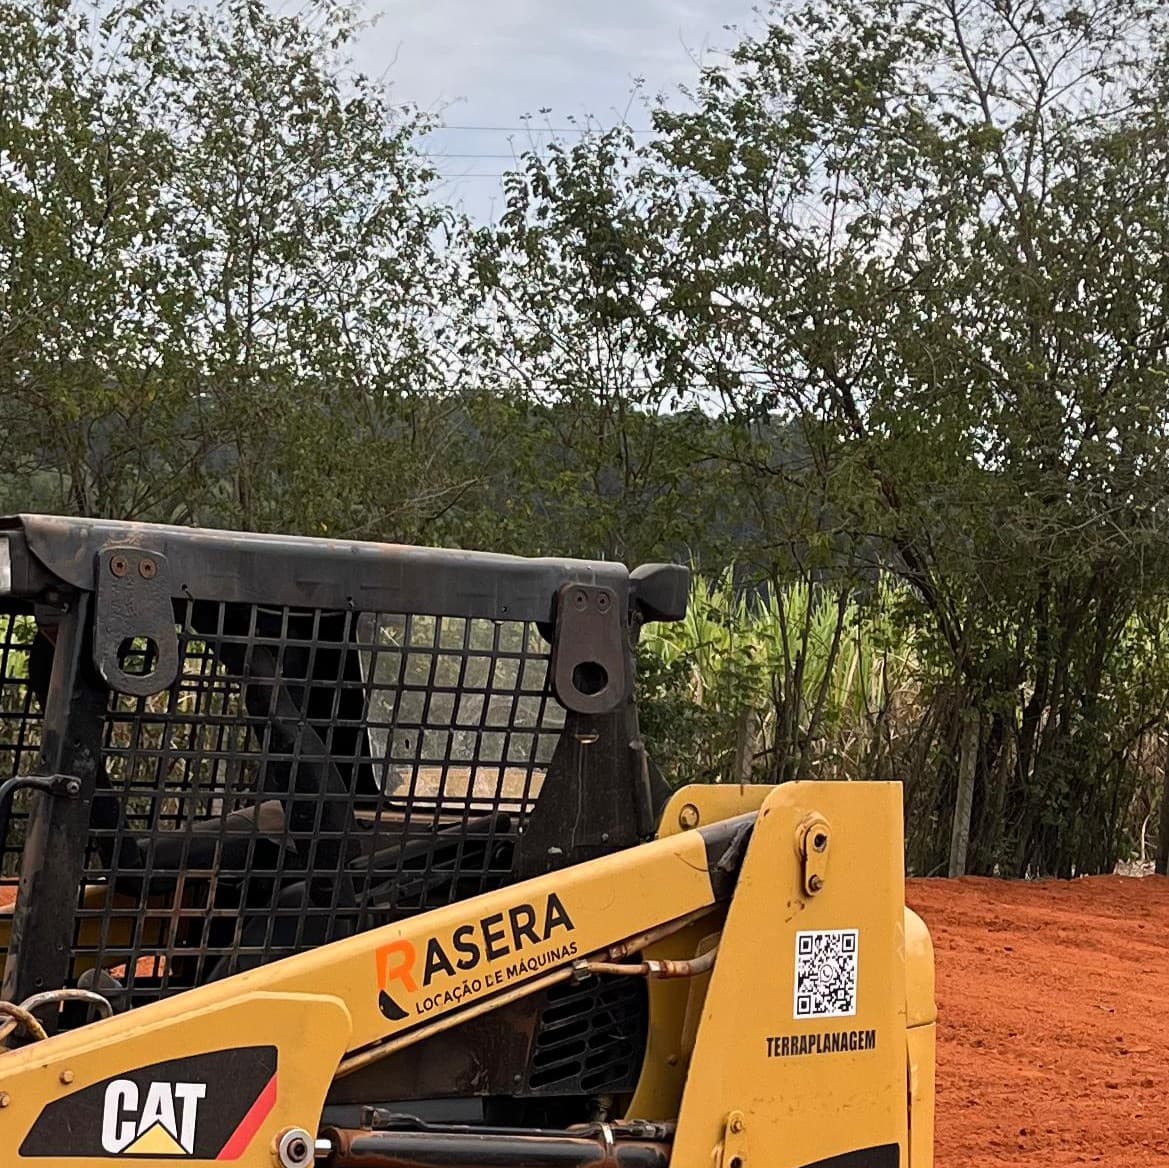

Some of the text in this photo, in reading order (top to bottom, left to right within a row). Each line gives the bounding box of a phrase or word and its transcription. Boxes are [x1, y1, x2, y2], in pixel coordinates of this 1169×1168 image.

[375, 892, 575, 994] RASERA
[415, 979, 482, 1015] LOCAÇÃO
[506, 941, 578, 982] MÁQUINAS
[766, 1029, 876, 1058] TERRAPLANAGEM
[101, 1079, 207, 1154] CAT
